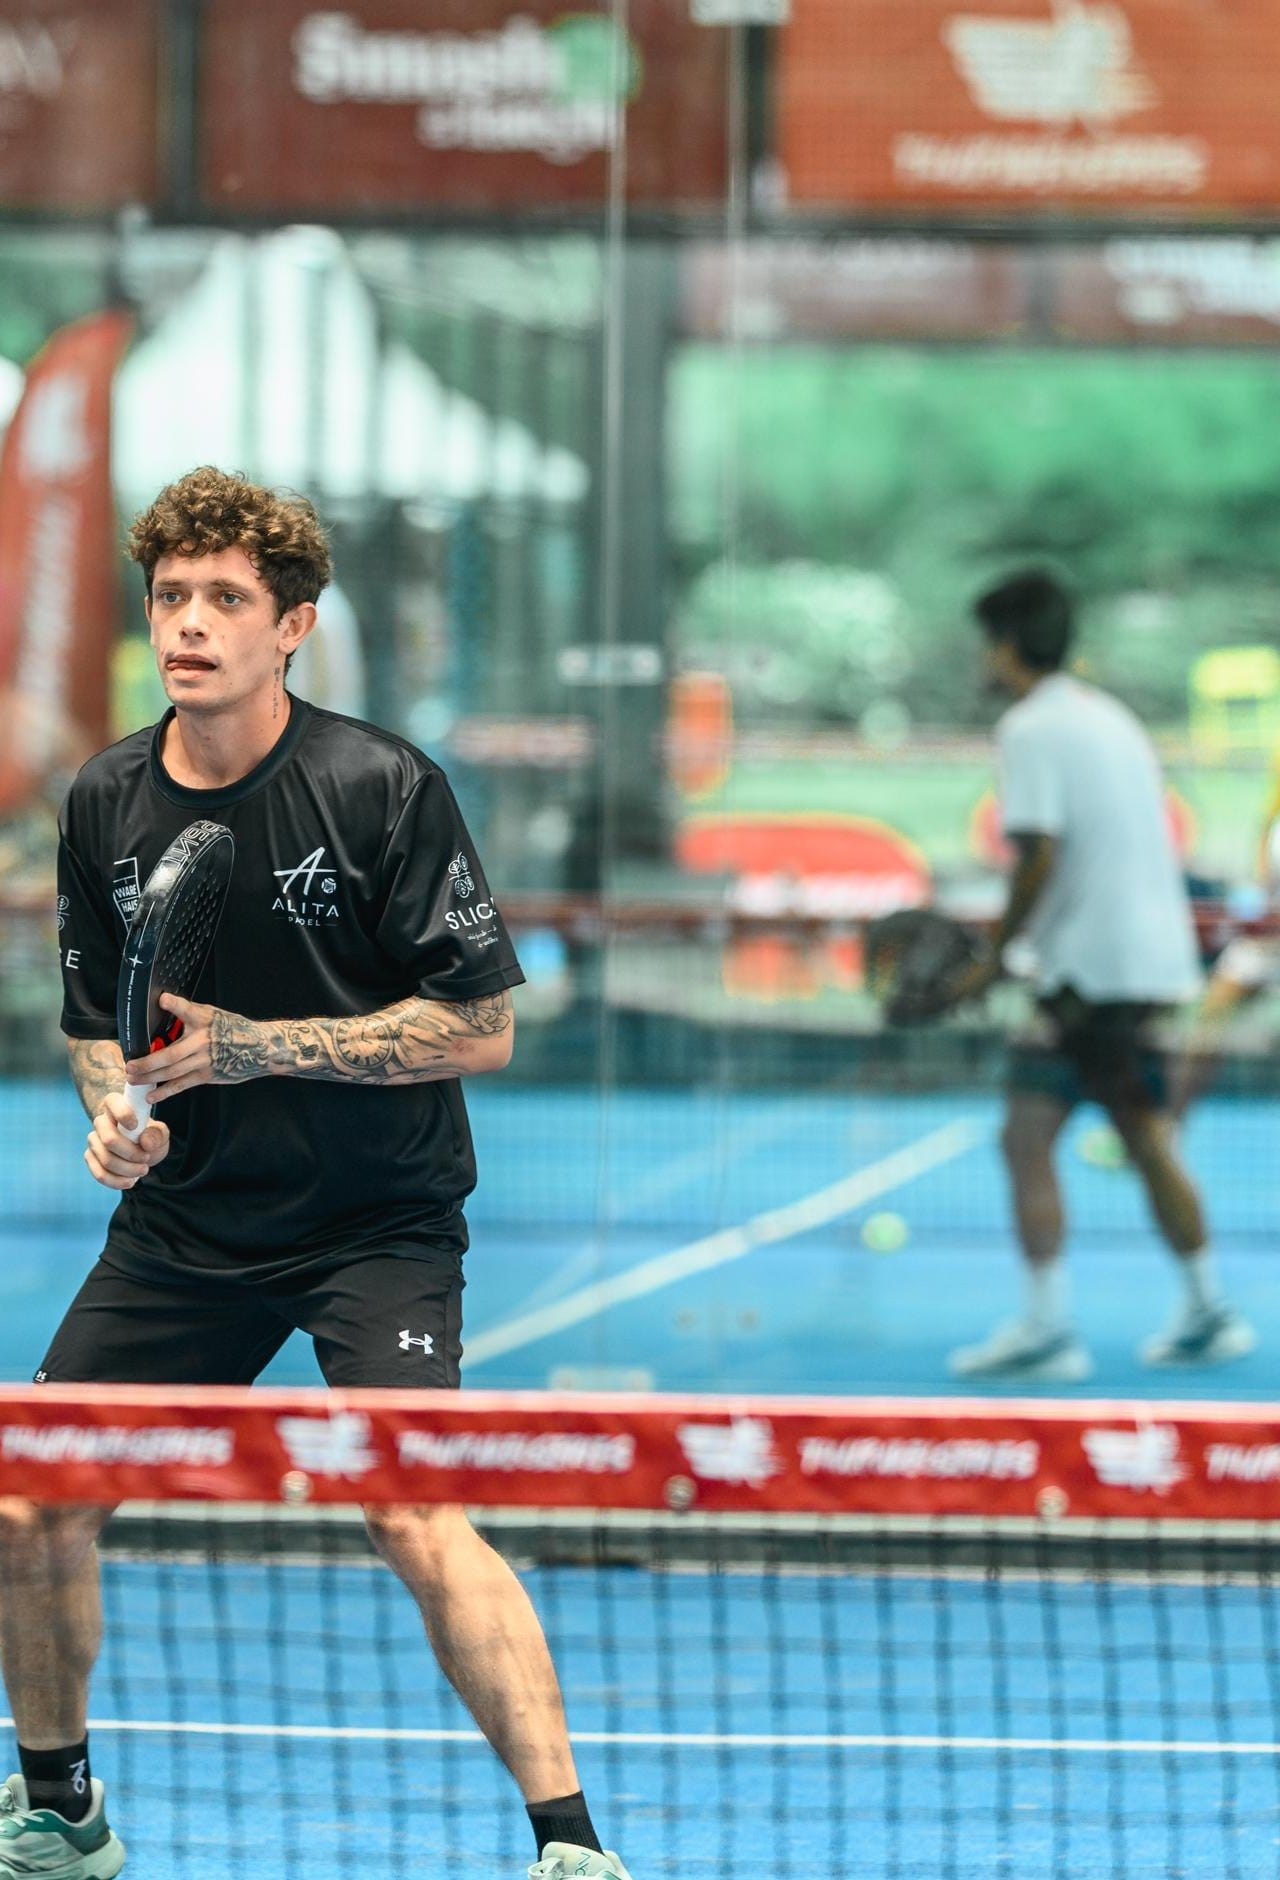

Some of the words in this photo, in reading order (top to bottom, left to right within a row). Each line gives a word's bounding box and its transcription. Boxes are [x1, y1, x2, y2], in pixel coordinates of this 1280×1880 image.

[115, 884, 137, 898] WARE
[272, 897, 339, 918] ALITA
[288, 916, 321, 926] PADEL
